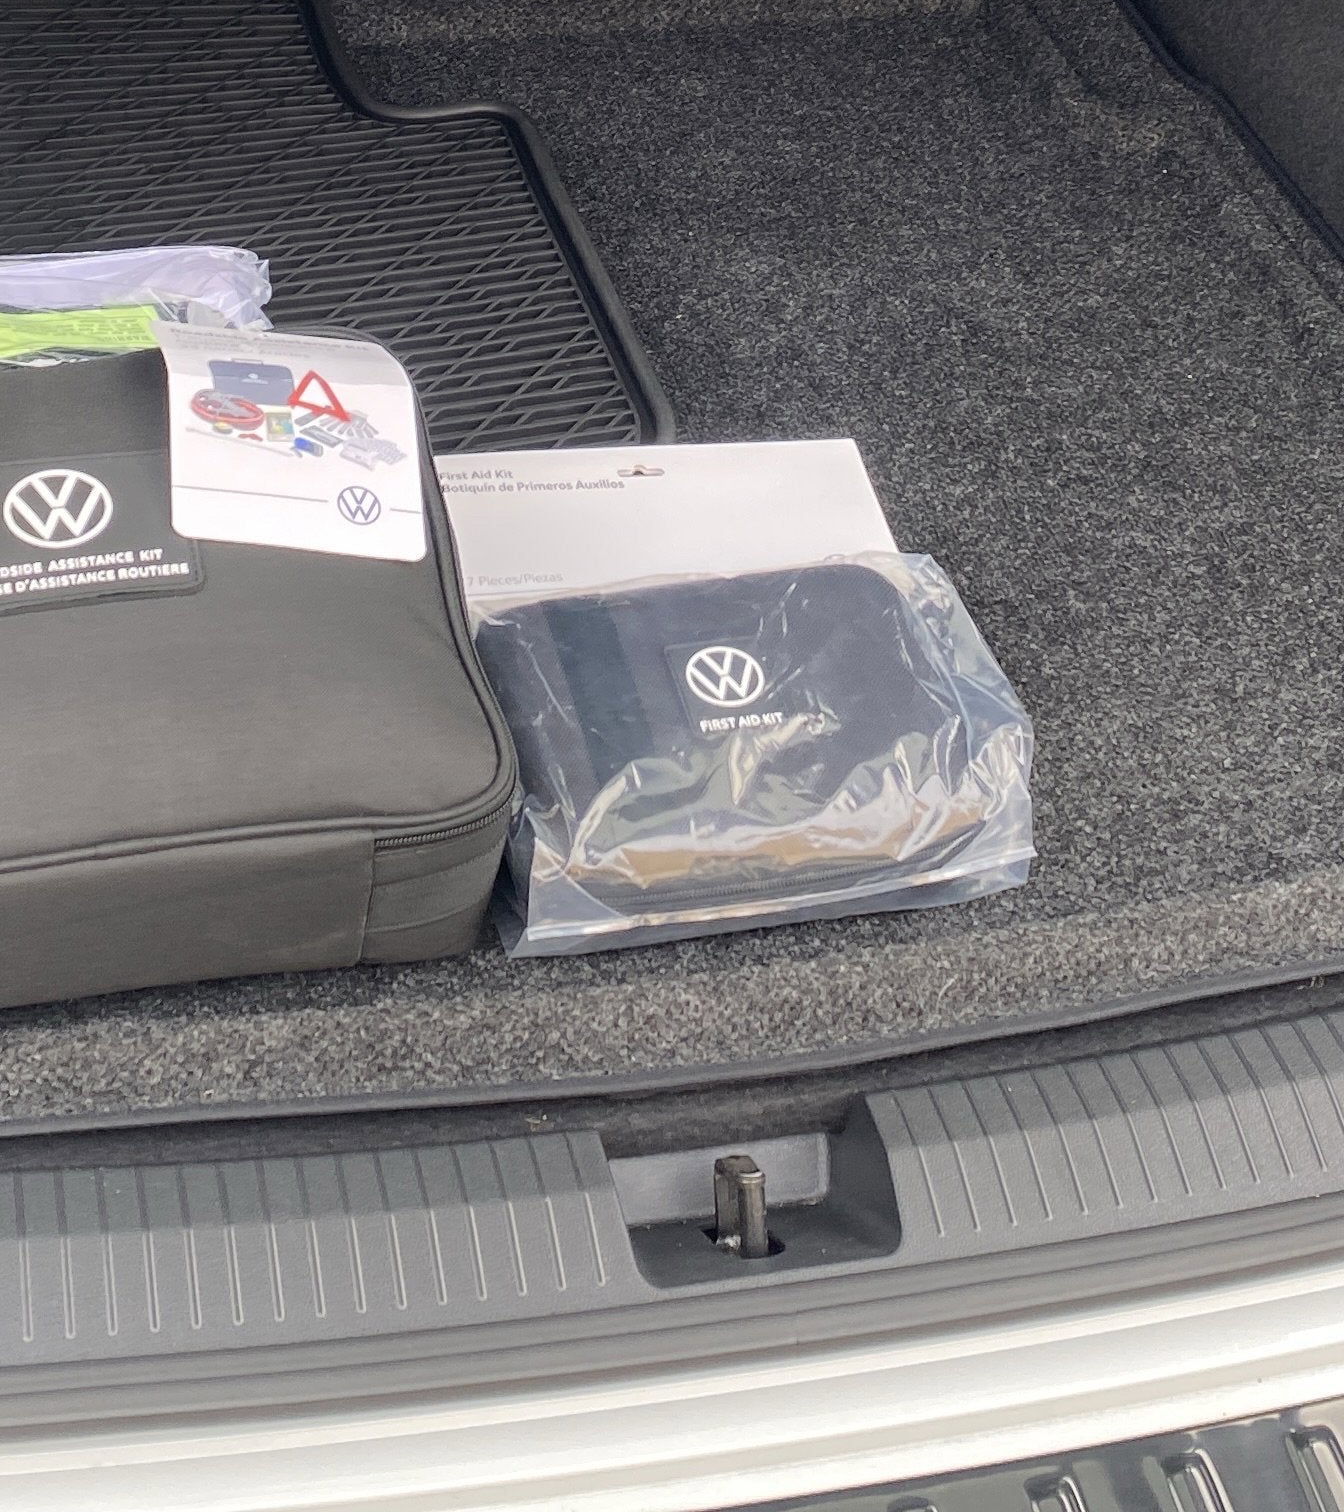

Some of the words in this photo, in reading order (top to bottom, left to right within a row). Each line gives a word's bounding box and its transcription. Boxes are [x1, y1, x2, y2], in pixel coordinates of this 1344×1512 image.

[439, 471, 469, 481] First
[471, 470, 492, 479] Aid
[495, 469, 514, 479] Kit
[498, 482, 514, 492] de
[516, 480, 574, 491] Primeros
[575, 478, 626, 489] Auxilios
[47, 550, 135, 572] ASSISTANCE
[138, 548, 164, 561] KIT
[14, 569, 116, 593] D'ASSISTANCE
[478, 573, 564, 586] Pieces/Piezas
[699, 716, 736, 733] FIRST
[738, 713, 761, 728] AID
[763, 711, 783, 724] KIT
